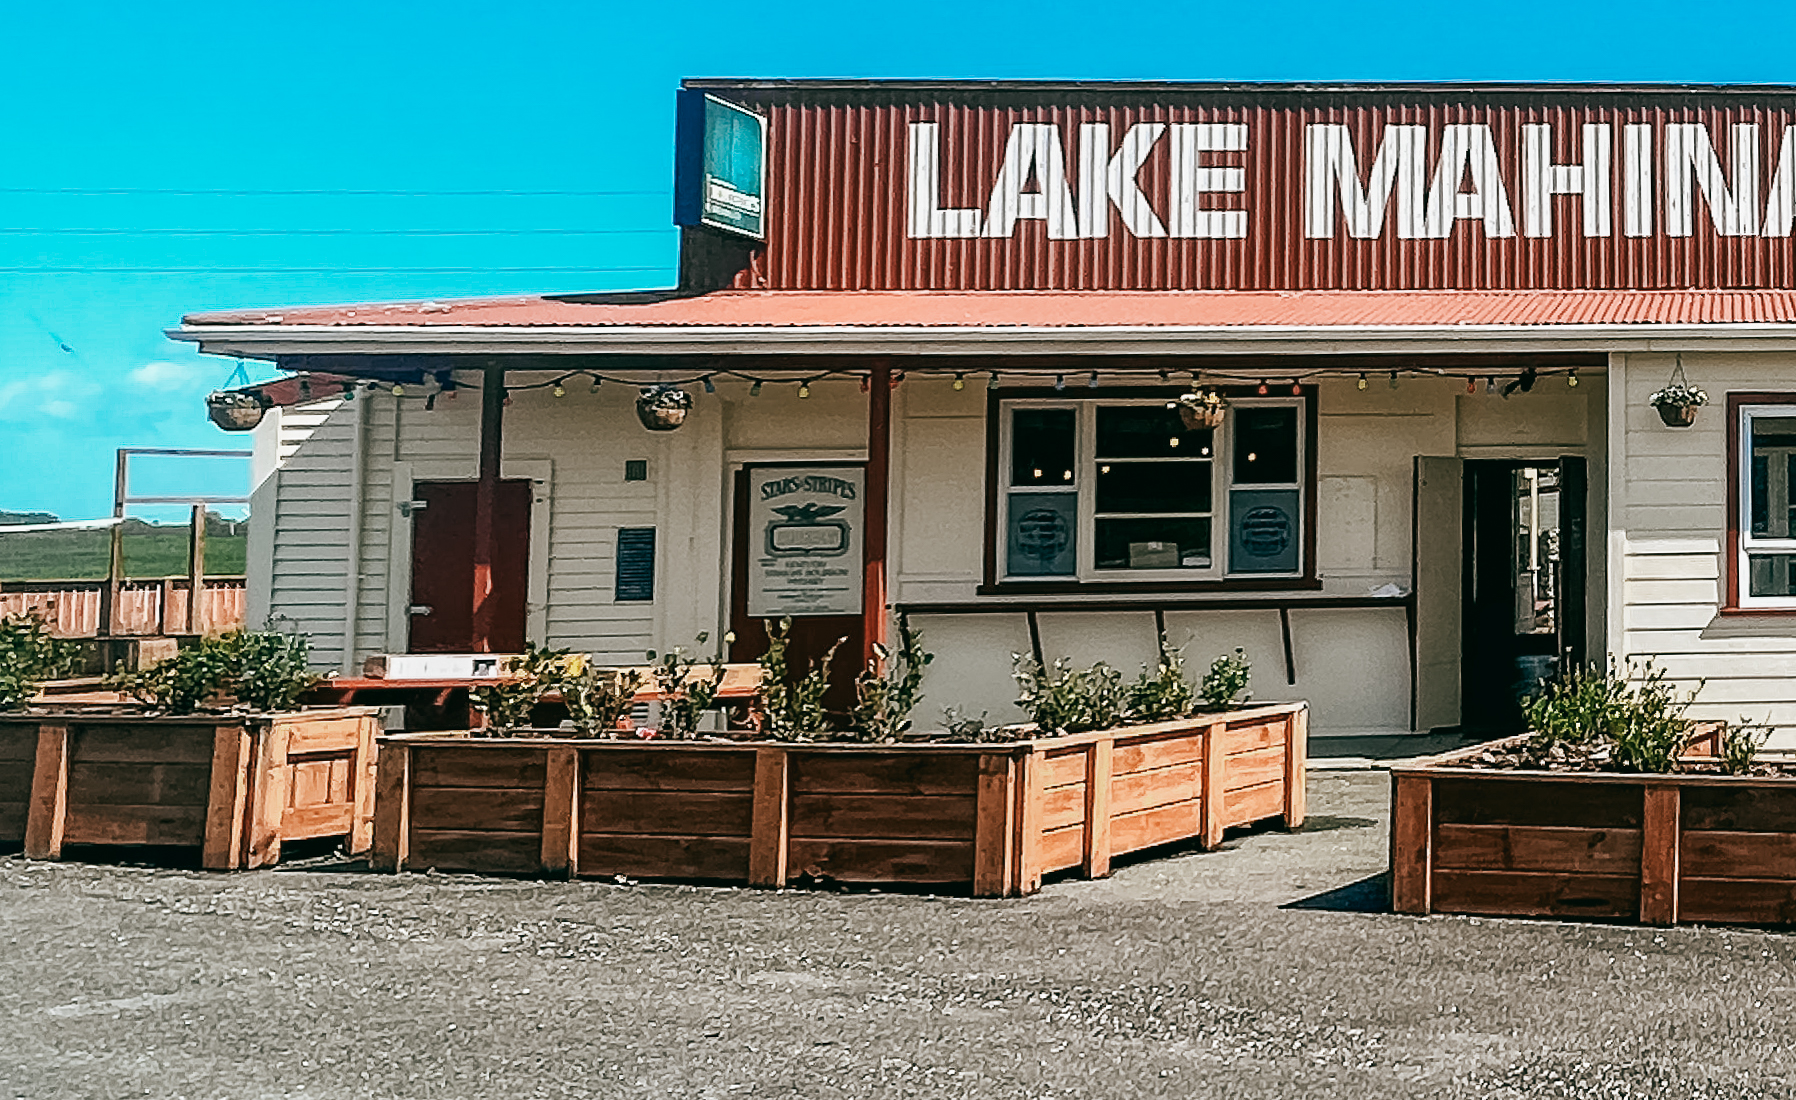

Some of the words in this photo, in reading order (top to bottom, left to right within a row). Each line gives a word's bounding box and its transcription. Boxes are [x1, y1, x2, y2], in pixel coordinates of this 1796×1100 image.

[907, 122, 1248, 240] LAKE
[760, 476, 801, 501] STARS
[803, 475, 857, 500] STRIPES
